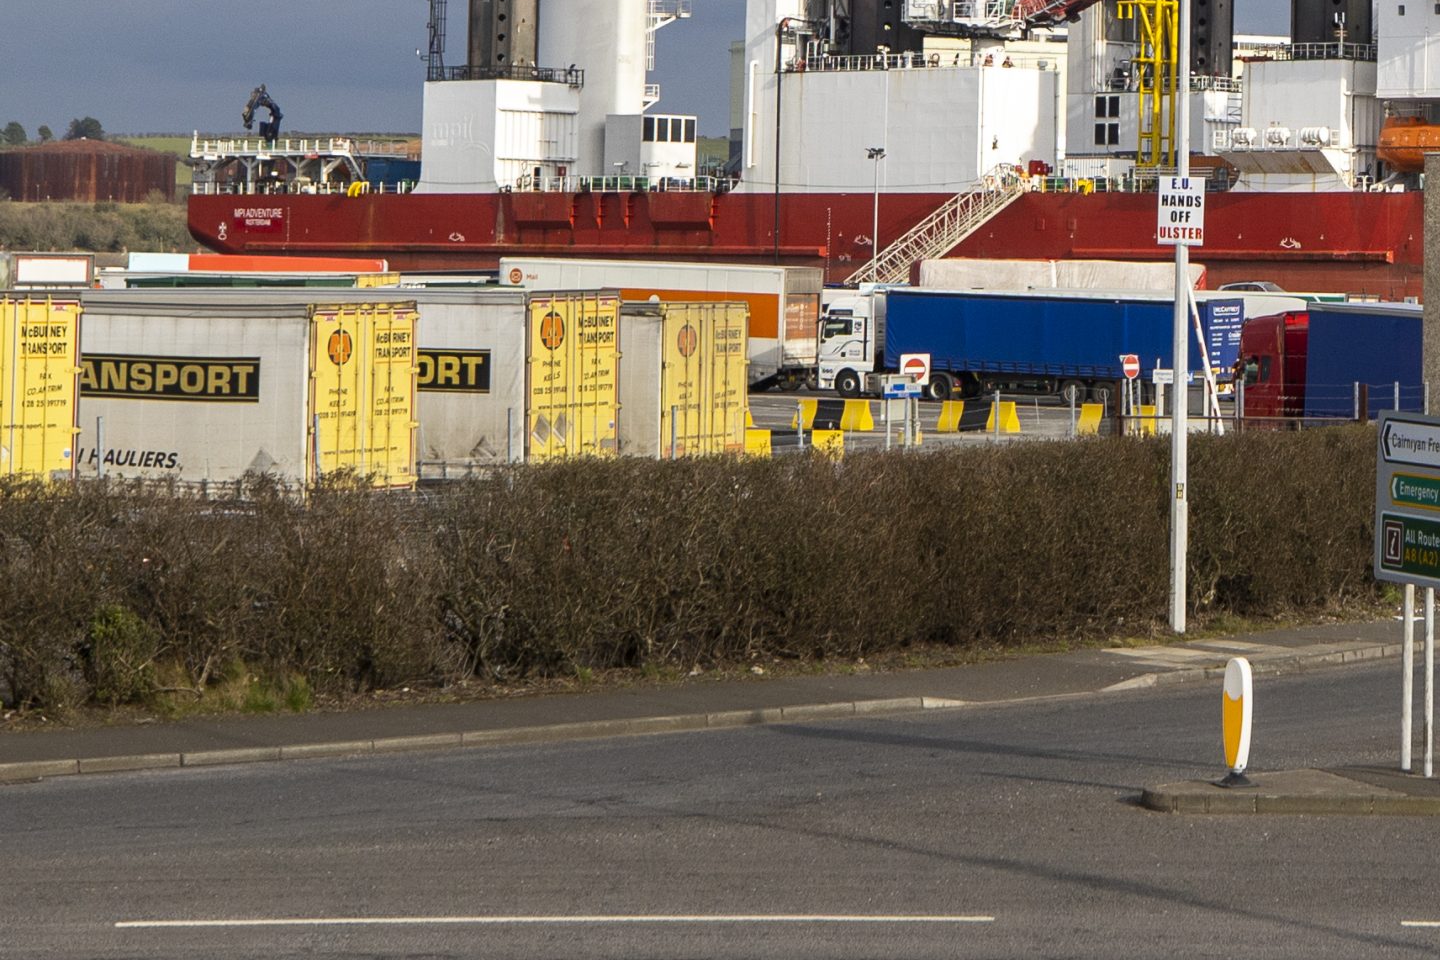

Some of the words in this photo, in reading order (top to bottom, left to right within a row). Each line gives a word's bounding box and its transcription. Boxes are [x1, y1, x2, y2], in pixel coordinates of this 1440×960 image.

[1171, 177, 1193, 190] E.U.
[1161, 194, 1202, 208] HANDS
[234, 208, 246, 218] MPI
[246, 208, 283, 218] ADVENTURE
[1170, 210, 1191, 223] OFF
[1159, 226, 1202, 239] ULSTER
[578, 316, 614, 329] McBUNEY
[376, 332, 411, 344] McBRNEY
[417, 354, 483, 386] ORT
[81, 360, 254, 395] ANSPORT
[1392, 433, 1426, 454] Cairnryan
[1400, 481, 1438, 504] Emergency
[1405, 529, 1416, 544] All
[1405, 548, 1417, 563] A8
[1419, 548, 1438, 567] (A2)
